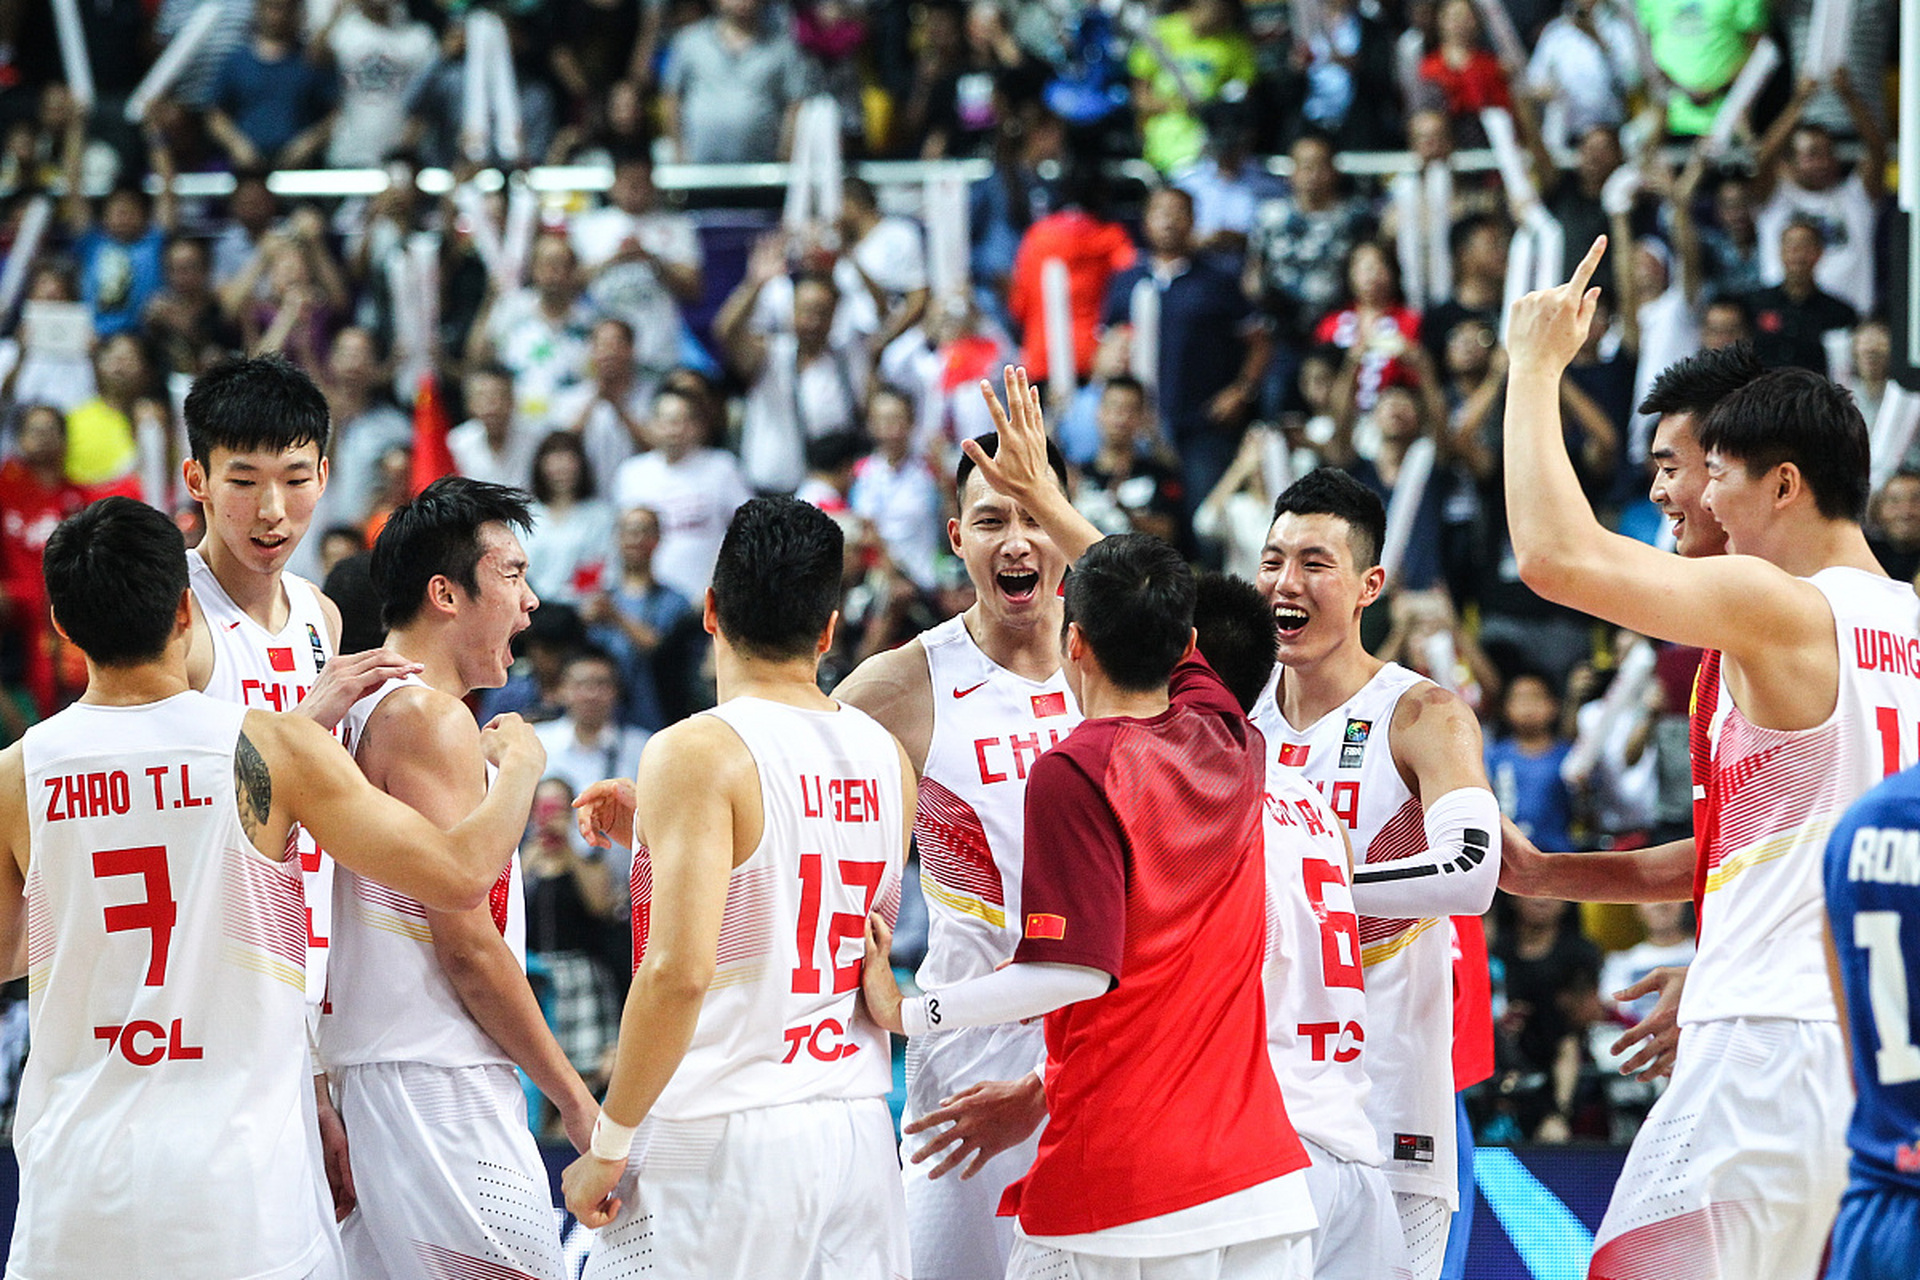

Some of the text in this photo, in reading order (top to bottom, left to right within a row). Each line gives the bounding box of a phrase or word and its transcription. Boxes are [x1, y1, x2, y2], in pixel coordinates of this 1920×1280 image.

[1853, 626, 1920, 680] WANG
[44, 764, 213, 822] ZHAO T.L.
[791, 853, 887, 995] 12
[1302, 857, 1365, 993] 6
[1297, 1020, 1365, 1063] TC
